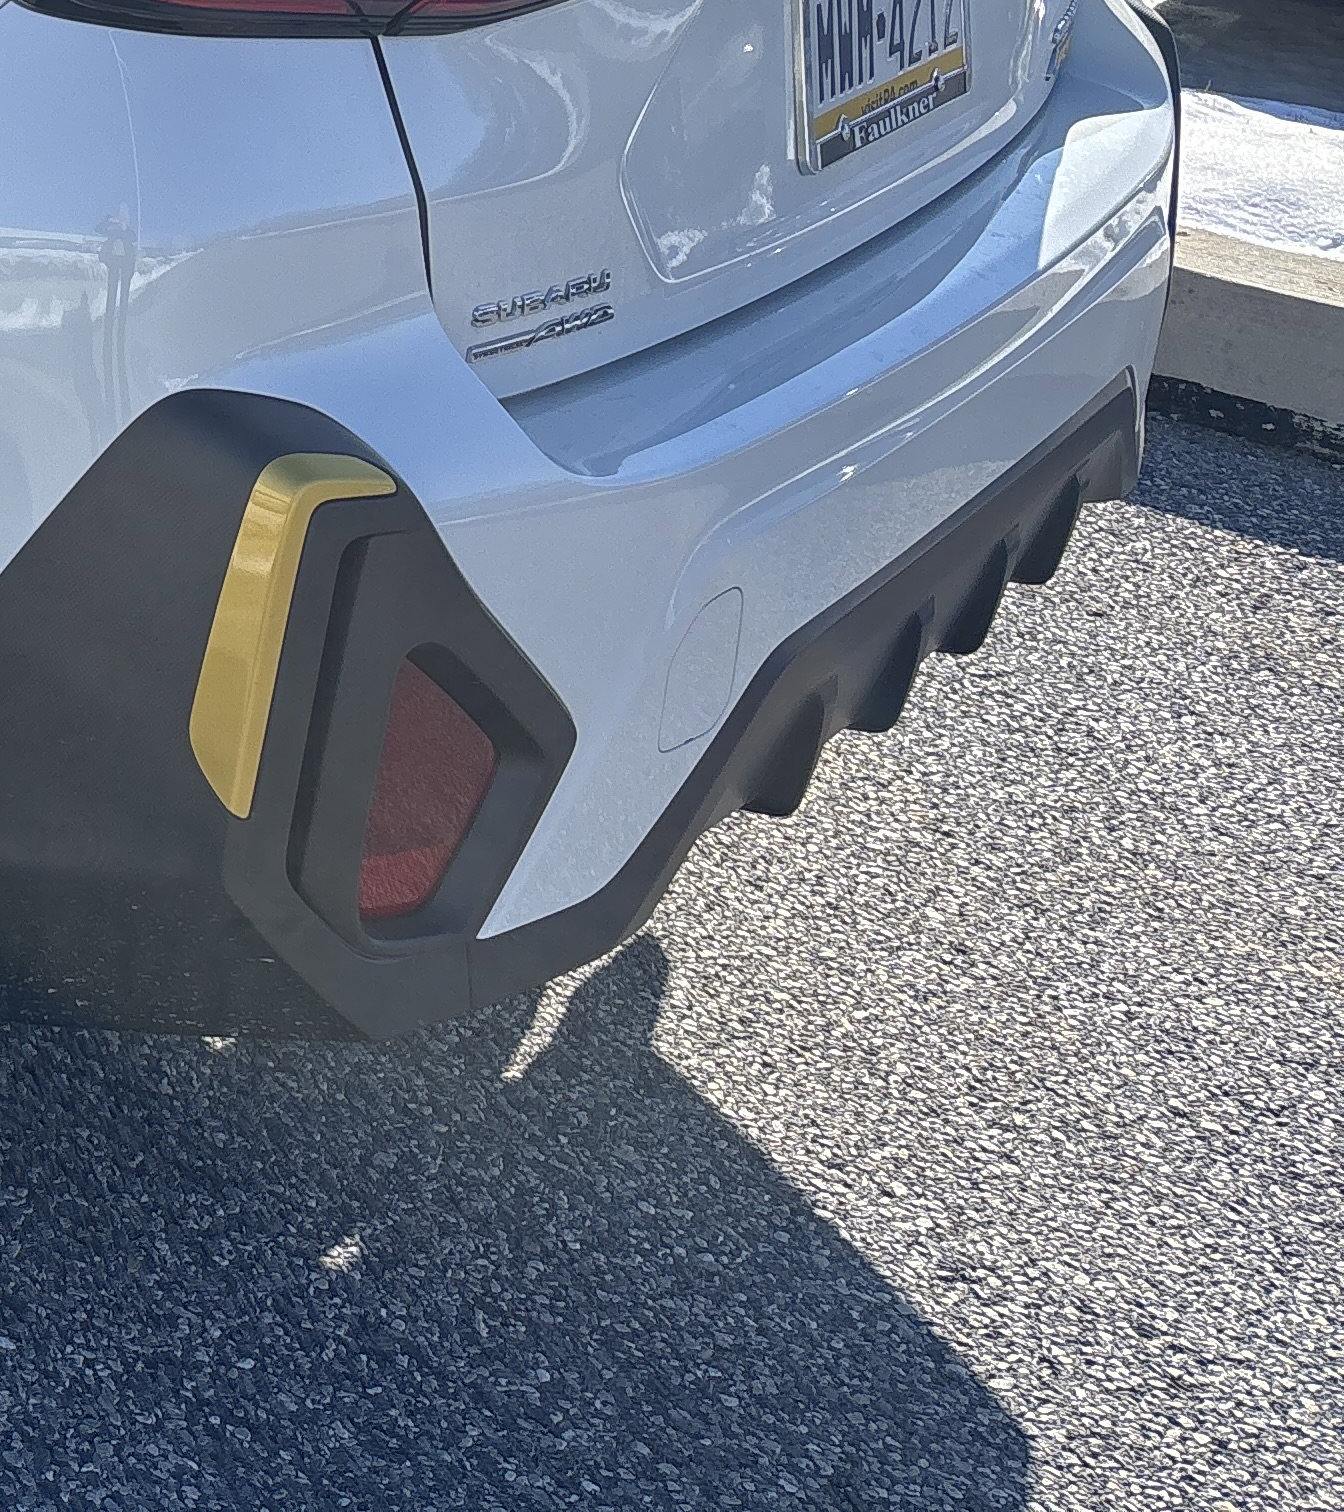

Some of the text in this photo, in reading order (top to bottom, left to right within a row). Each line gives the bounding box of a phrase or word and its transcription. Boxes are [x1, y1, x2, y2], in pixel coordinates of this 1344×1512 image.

[851, 91, 937, 148] Faulkner
[860, 79, 918, 115] visitPAcom
[470, 267, 612, 328] SUBARU
